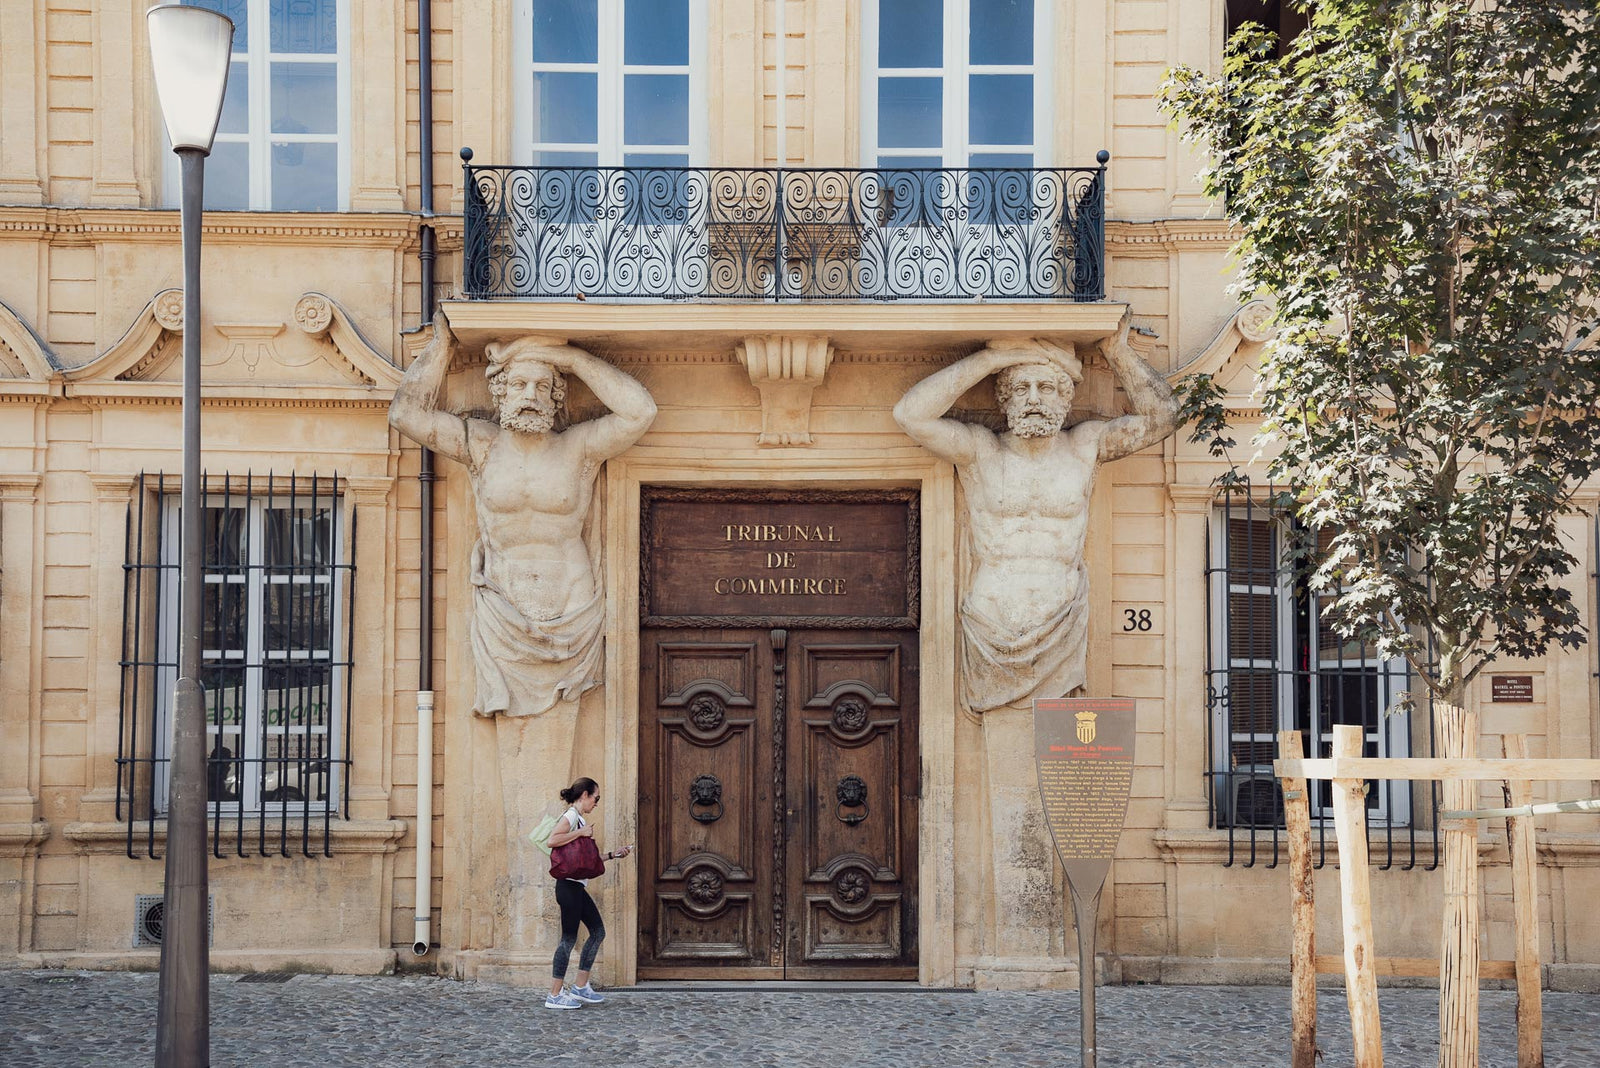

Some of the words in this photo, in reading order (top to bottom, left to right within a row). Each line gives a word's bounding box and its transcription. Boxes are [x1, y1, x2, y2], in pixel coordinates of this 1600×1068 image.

[721, 524, 841, 541] TRIBUNAL
[767, 551, 796, 569] DE
[714, 577, 847, 595] COMMERCE
[1123, 608, 1153, 632] 38
